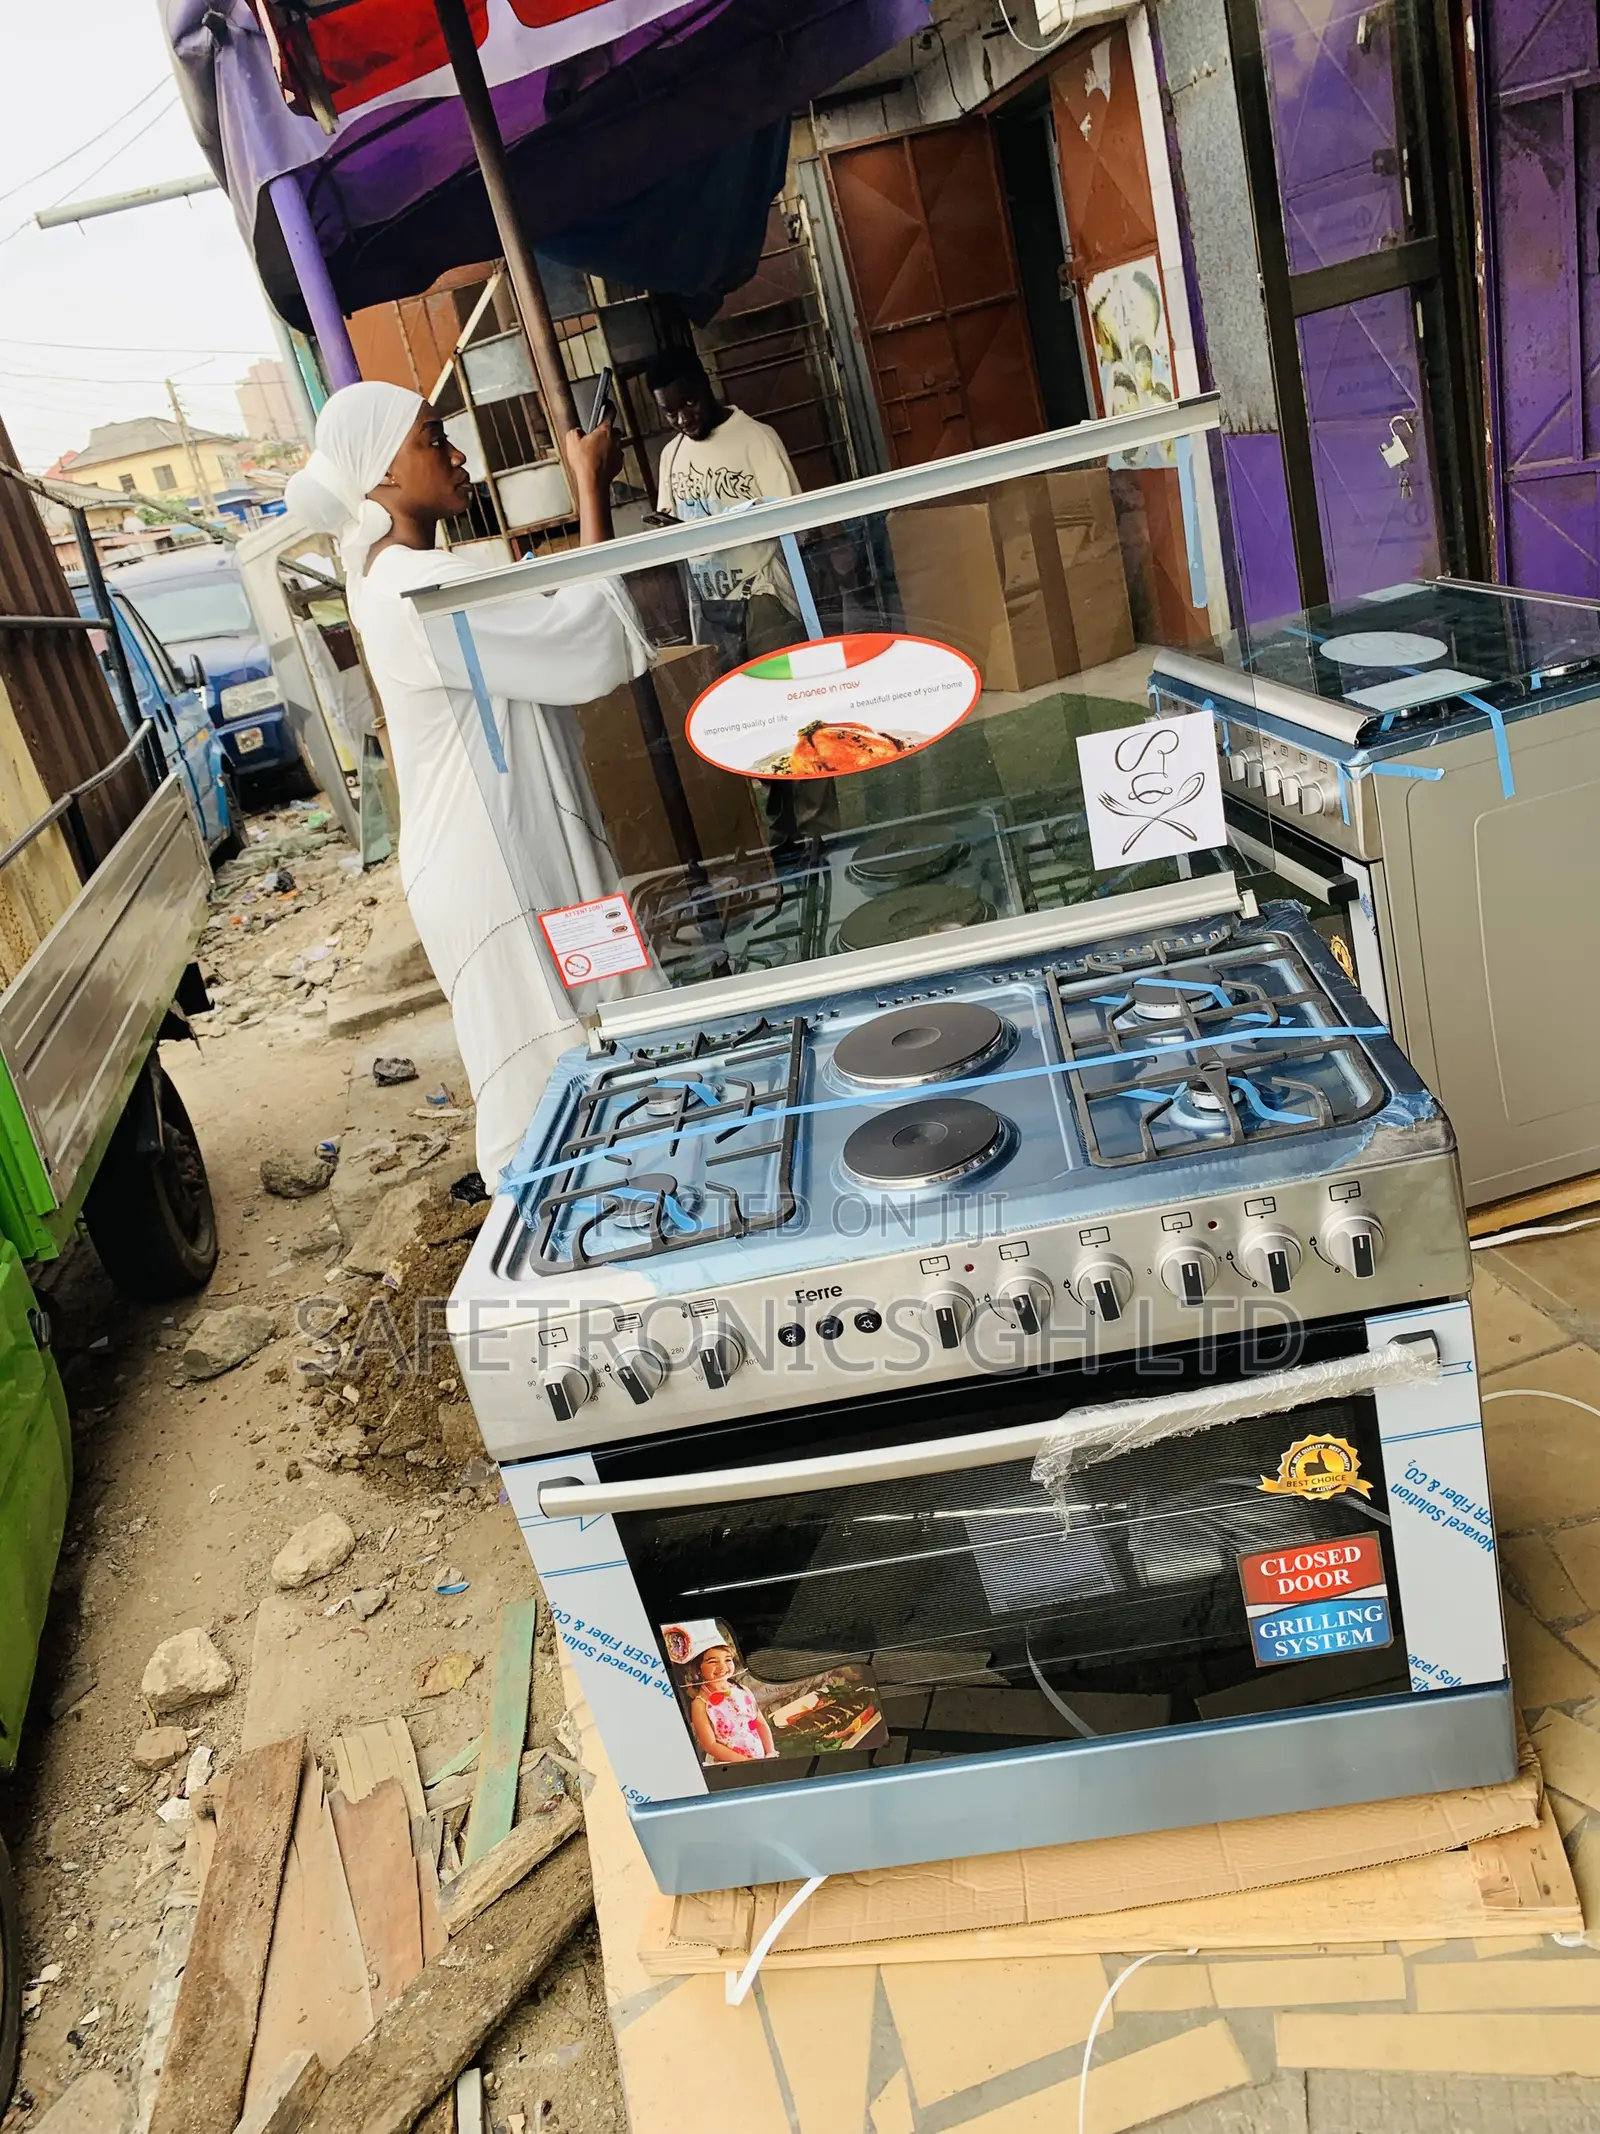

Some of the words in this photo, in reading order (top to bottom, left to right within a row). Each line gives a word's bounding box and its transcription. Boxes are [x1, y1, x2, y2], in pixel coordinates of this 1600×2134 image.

[787, 687, 827, 700] DESIGNED
[829, 685, 838, 693] IN
[840, 680, 861, 691] ITALY
[856, 694, 891, 708] beautifull
[892, 690, 912, 702] piece
[922, 685, 941, 696] your
[941, 680, 963, 690] home
[703, 722, 741, 736] improving
[741, 718, 767, 731] quality
[768, 715, 776, 724] of
[777, 714, 788, 723] life
[795, 1285, 843, 1304] Ferre
[671, 1346, 685, 1355] 280
[745, 1358, 760, 1366] 100
[527, 1379, 537, 1387] 90
[1286, 1480, 1309, 1488] BEST
[1311, 1475, 1347, 1485] CHOICE
[1427, 1479, 1441, 1492] &
[1390, 1483, 1446, 1522] Solution
[1439, 1487, 1476, 1513] Fiber
[1441, 1515, 1494, 1553] Novacel
[1260, 1546, 1362, 1577] CLOSED
[1277, 1568, 1353, 1596] DOOR
[573, 1619, 585, 1632] &
[1259, 1605, 1384, 1639] GRILLING
[585, 1626, 623, 1650] Fiber
[1274, 1626, 1375, 1657] SYSTEM
[595, 1652, 653, 1686] Novacel
[622, 1644, 666, 1674] ASER
[1408, 1653, 1439, 1675] acel
[653, 1679, 675, 1699] The
